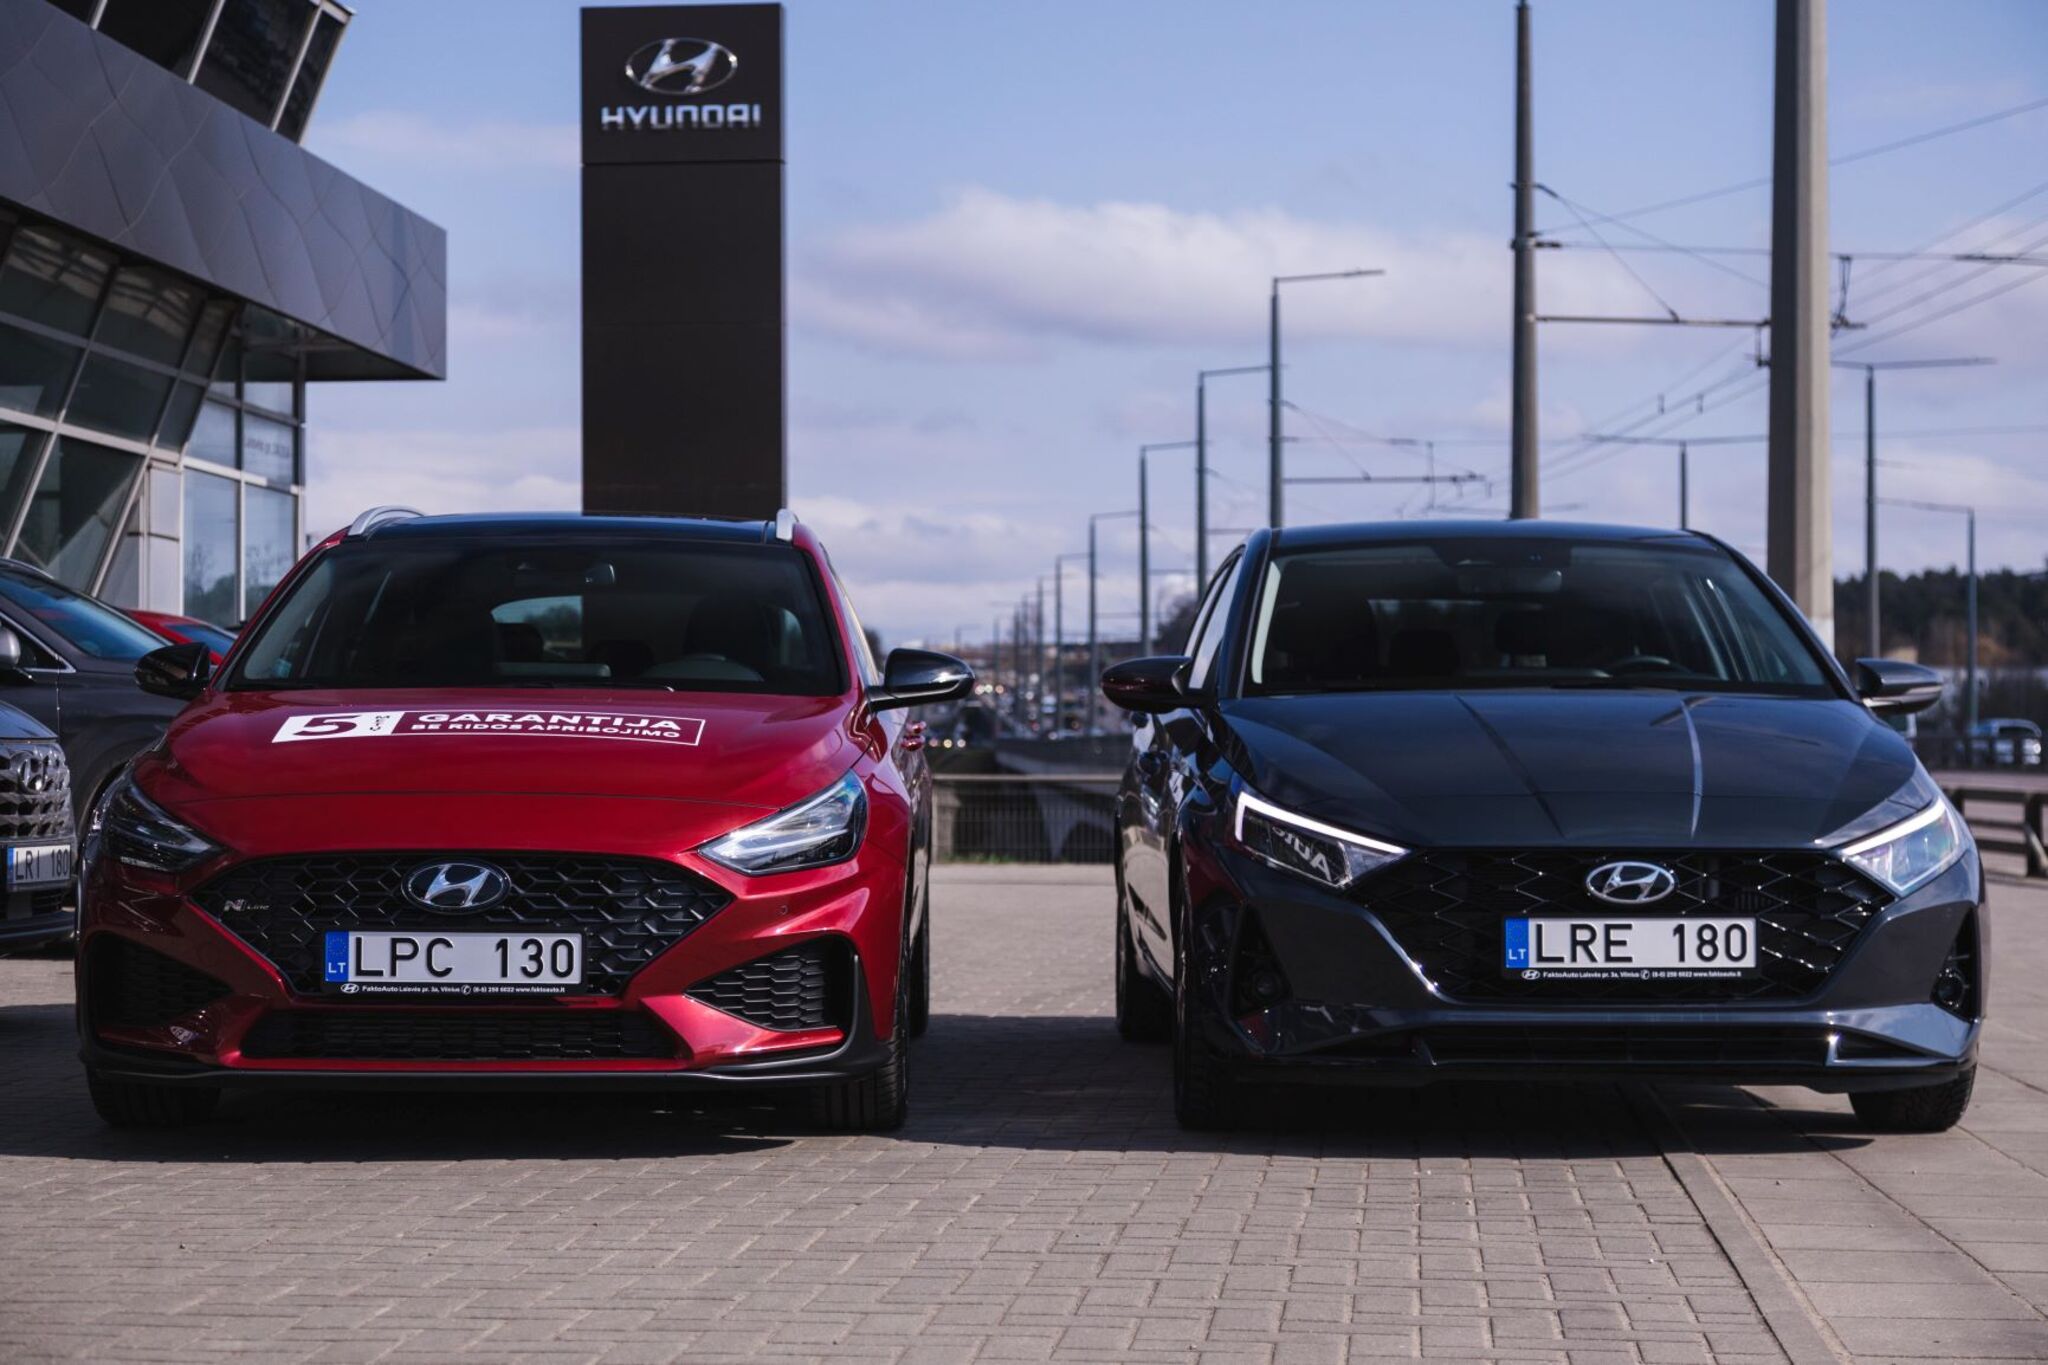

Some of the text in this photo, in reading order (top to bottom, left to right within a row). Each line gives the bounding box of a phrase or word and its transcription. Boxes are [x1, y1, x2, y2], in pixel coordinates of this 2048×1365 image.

[601, 103, 761, 129] HYUNDAI
[293, 714, 362, 736] 5
[411, 723, 682, 738] BE RIDOS APRIBOJIMO
[418, 713, 682, 731] GARANTIJA
[51, 848, 70, 878] 180
[1536, 923, 1747, 963] LRE 180
[356, 936, 574, 978] LPC 130
[1508, 949, 1526, 960] LT
[328, 962, 346, 973] LT
